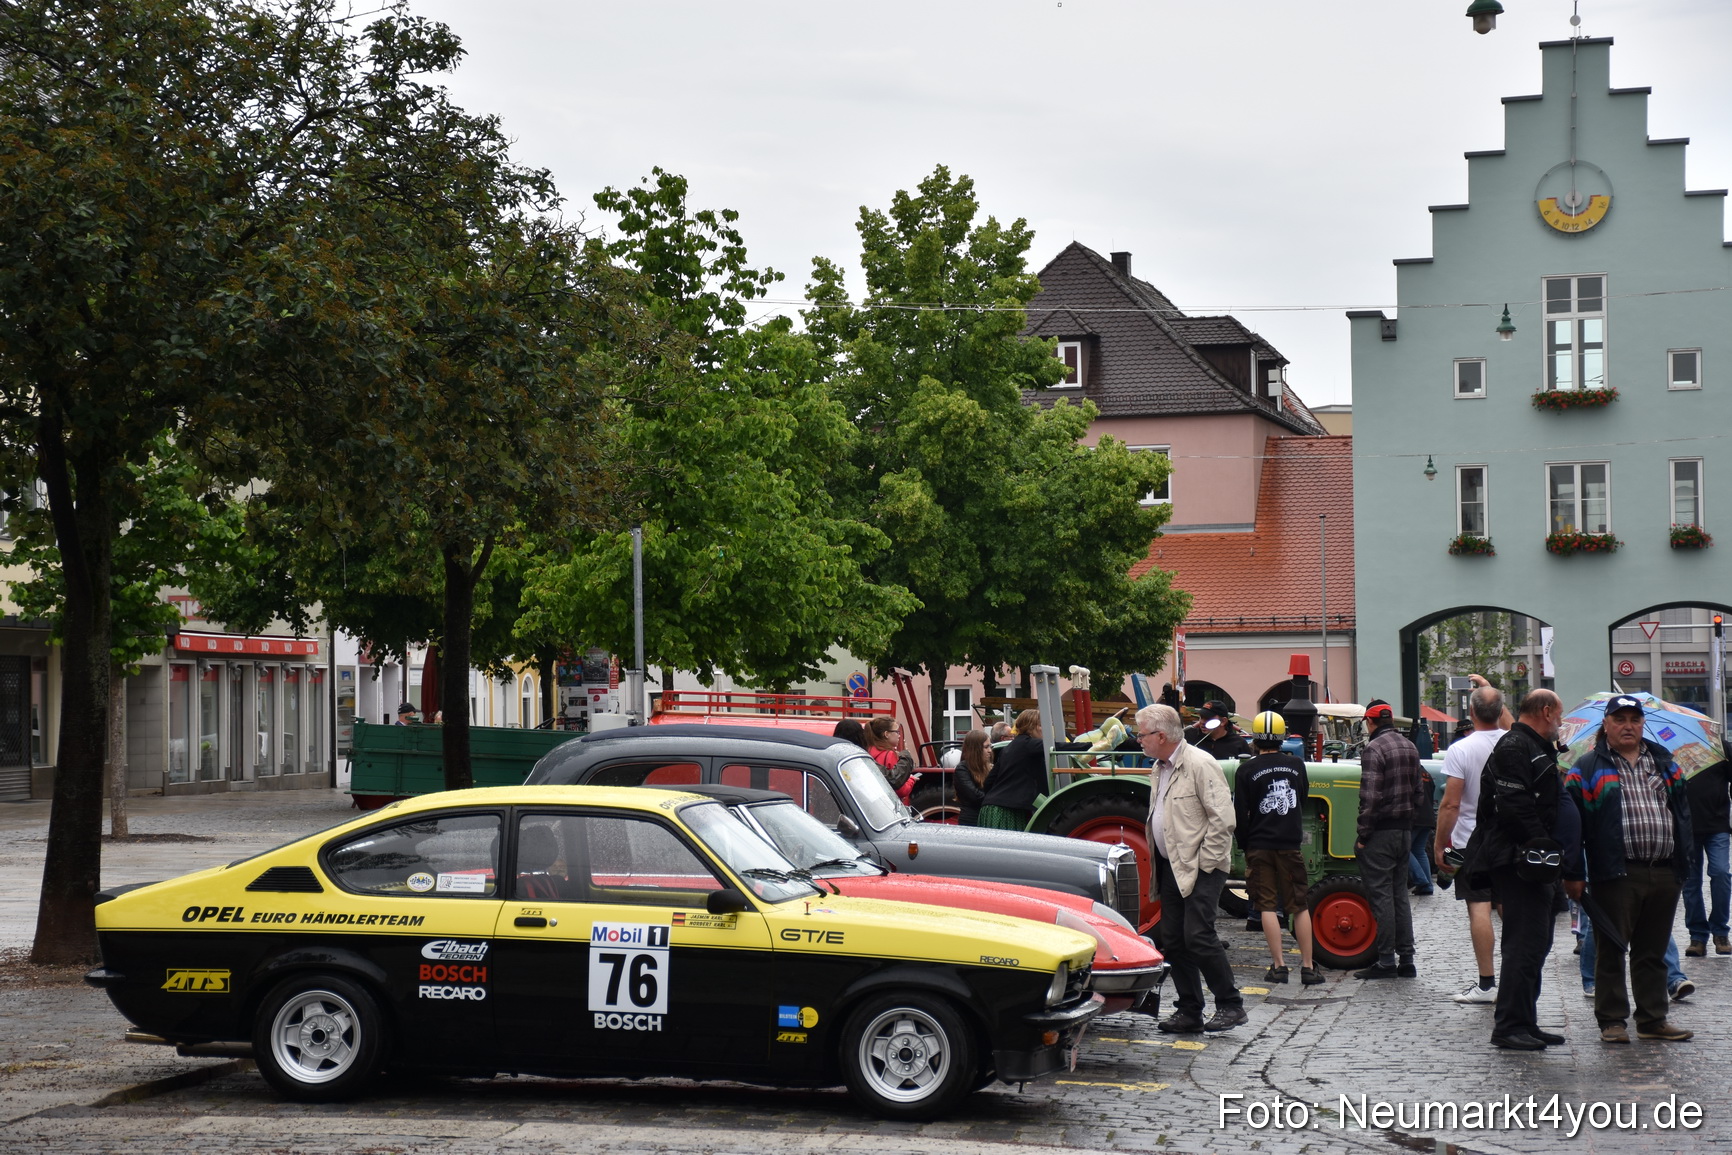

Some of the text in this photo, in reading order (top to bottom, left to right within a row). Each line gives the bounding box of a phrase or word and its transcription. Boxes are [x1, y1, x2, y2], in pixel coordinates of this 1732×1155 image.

[1584, 218, 1593, 227] 14
[182, 905, 425, 927] OPEL EURO HÄNDLERTEAM
[592, 926, 662, 946] Mobil 1
[780, 928, 845, 945] GT/E
[421, 940, 488, 960] Eibach
[979, 955, 1020, 967] RECARO
[160, 971, 232, 990] ATS
[419, 964, 487, 982] BOSCH
[599, 953, 658, 1008] 76
[418, 985, 486, 1000] RECARO
[594, 1013, 662, 1031] BOSCH
[776, 1032, 808, 1043] ATS
